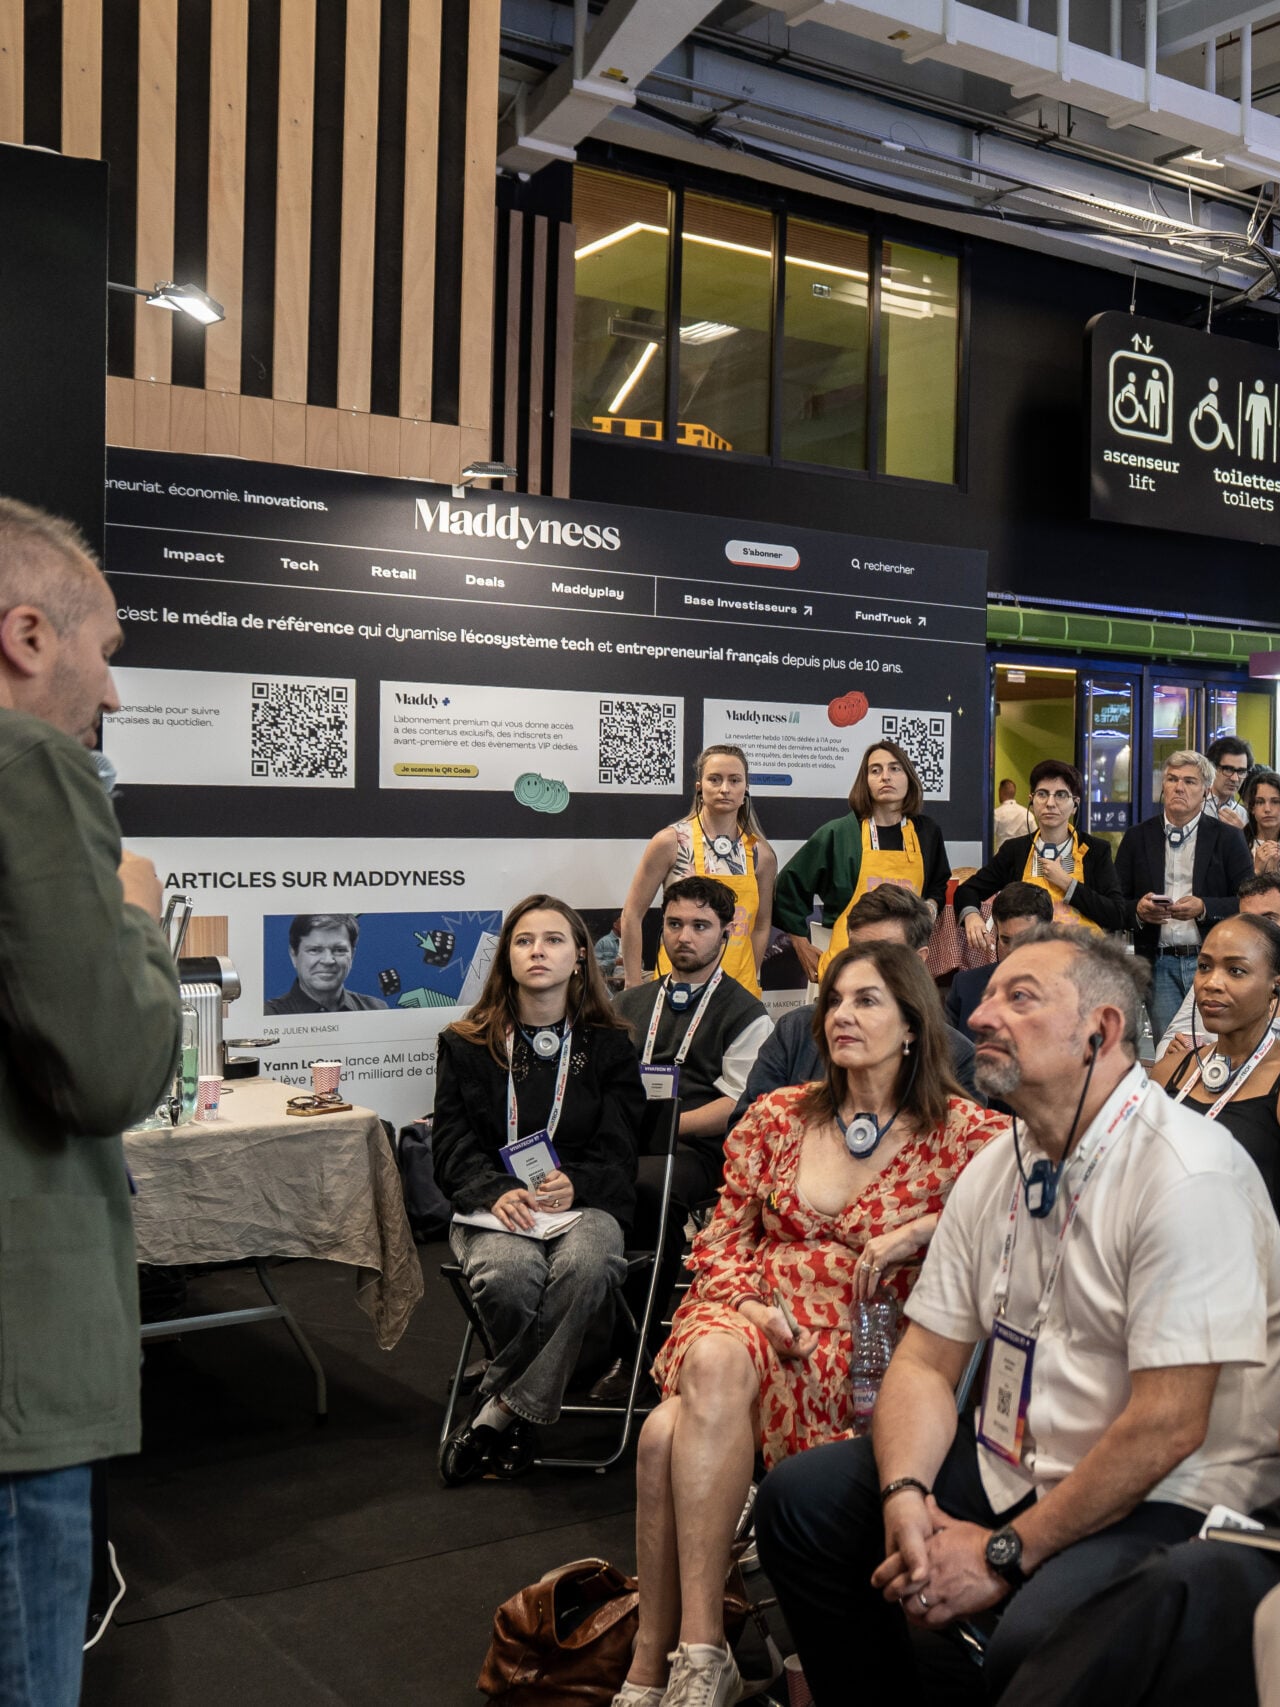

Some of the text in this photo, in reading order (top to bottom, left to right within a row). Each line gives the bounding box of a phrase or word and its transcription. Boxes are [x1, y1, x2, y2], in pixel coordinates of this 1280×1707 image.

[1103, 449, 1180, 474] ascenseur
[1129, 474, 1156, 492] lift
[243, 490, 329, 512] innovations.
[1222, 489, 1274, 512] toilets
[414, 498, 622, 551] Maddyness
[742, 547, 783, 560] S'abonner
[163, 547, 625, 601] Impact Tech Retail Deals Maddyplay
[864, 559, 915, 576] rechercher
[684, 594, 798, 615] Base Investisseurs
[854, 610, 912, 626] FundTruck
[116, 605, 904, 674] c'est le média de référence qui dynamise l'écosystème tech et entrepreneurial français depuis plus de 10 ans.
[165, 706, 189, 716] pour
[191, 707, 220, 716] suivre
[726, 709, 800, 725] Maddyness IA
[166, 717, 214, 728] quotidien.
[452, 717, 489, 727] premium
[490, 719, 503, 728] qui
[525, 721, 549, 729] donne
[401, 727, 417, 735] des
[419, 727, 458, 736] contenus
[497, 730, 511, 738] des
[513, 731, 551, 739] indiscrets
[797, 735, 816, 743] dédiée
[471, 740, 486, 748] des
[538, 742, 551, 750] VIP
[165, 870, 466, 889] ARTICLES SUR MADDYNESS
[263, 1025, 340, 1036] PAR JULIEN KHASKI
[263, 1060, 299, 1072] Yann
[345, 1056, 380, 1066] lance
[383, 1053, 405, 1064] AMI
[408, 1051, 435, 1062] Labs
[358, 1066, 404, 1080] milliard
[411, 1066, 423, 1076] de
